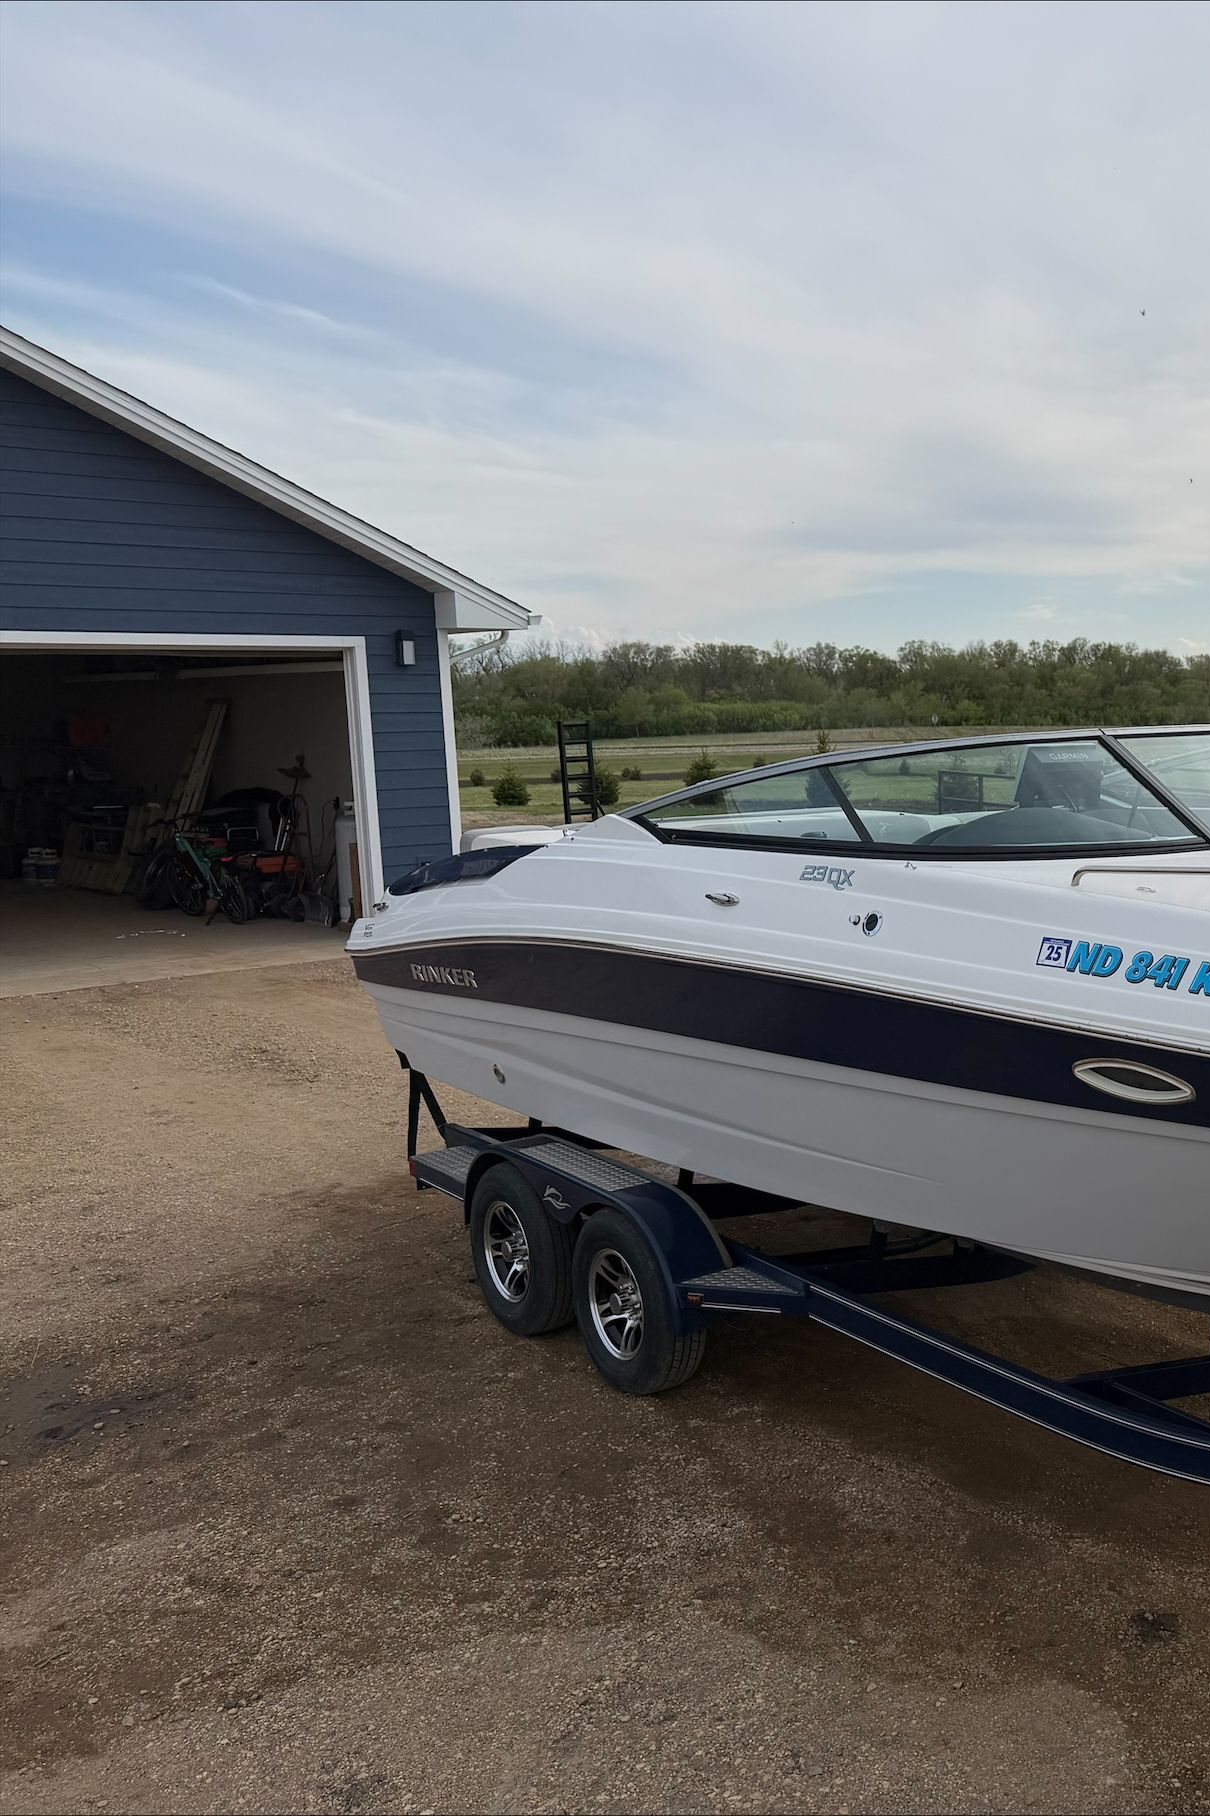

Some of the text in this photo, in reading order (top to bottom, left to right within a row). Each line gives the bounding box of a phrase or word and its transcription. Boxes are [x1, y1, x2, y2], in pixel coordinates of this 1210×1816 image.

[1048, 752, 1089, 760] GARMIN
[799, 864, 855, 891] 23QX
[1045, 944, 1063, 961] 25
[409, 963, 478, 988] RINKER
[1066, 941, 1123, 977] ND
[1125, 951, 1190, 990] 841
